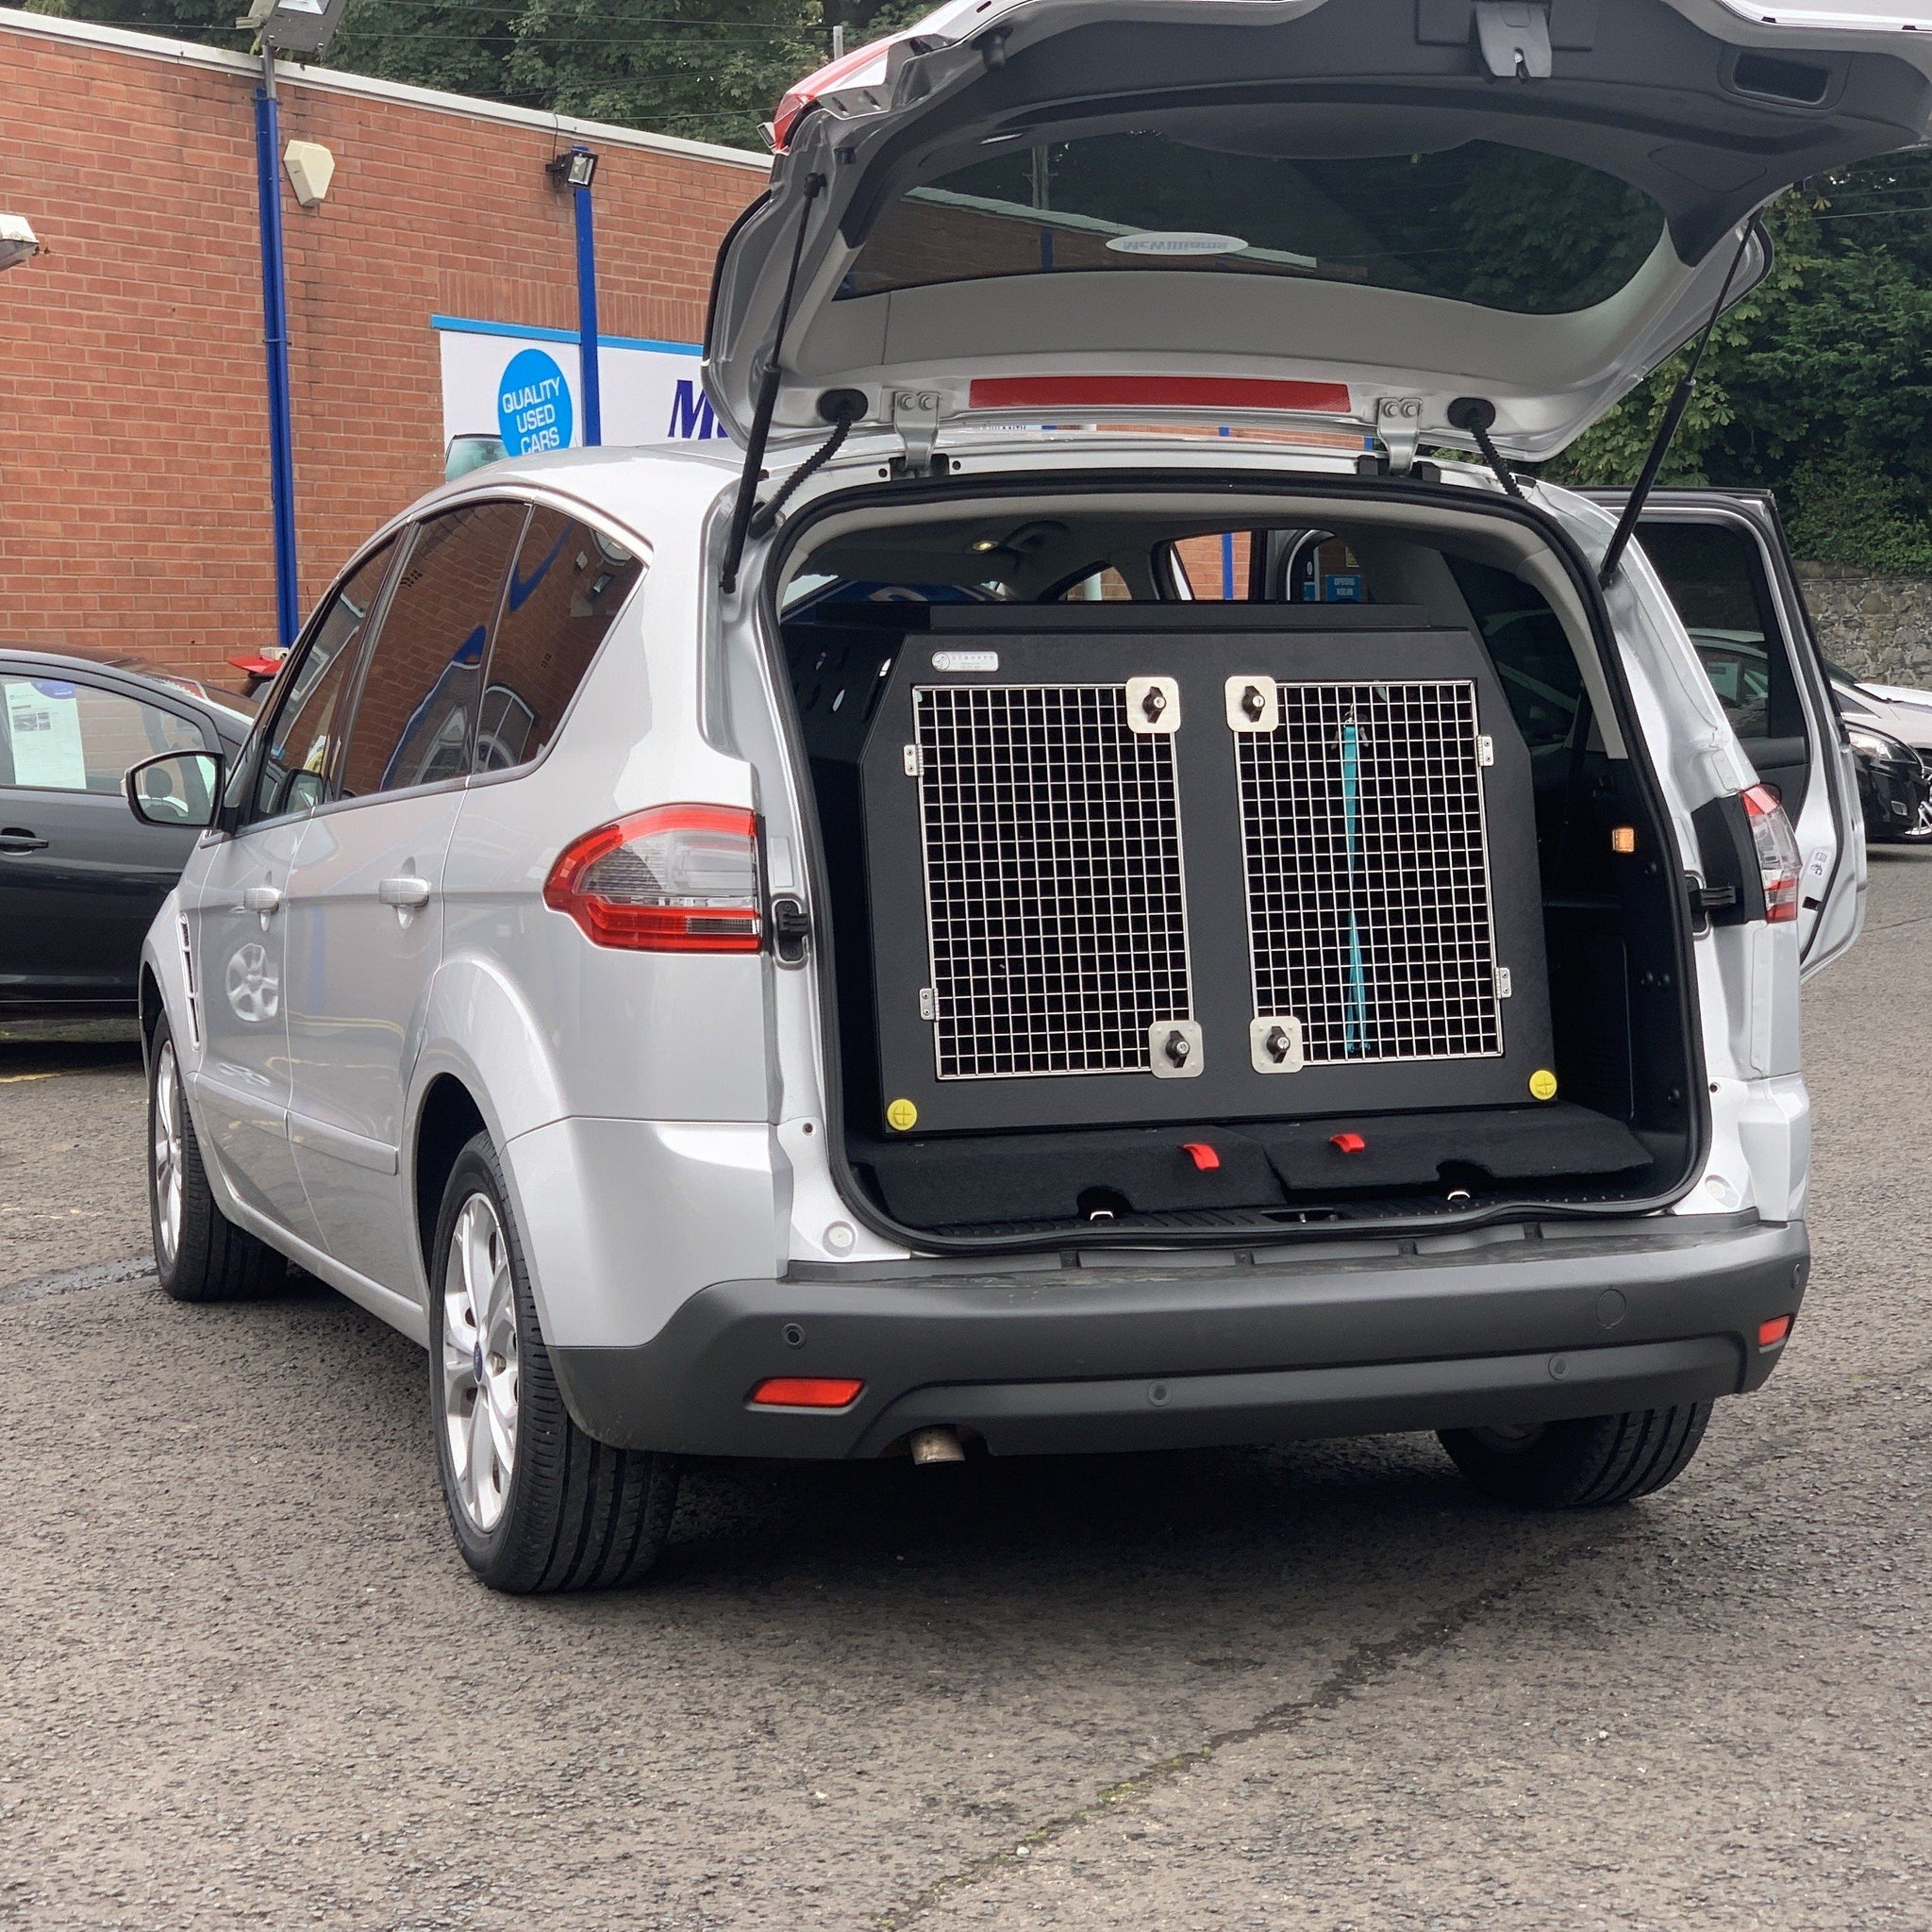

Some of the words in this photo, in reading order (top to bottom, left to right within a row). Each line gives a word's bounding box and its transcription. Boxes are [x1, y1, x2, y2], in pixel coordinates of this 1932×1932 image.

[502, 376, 560, 413] QUALITY
[516, 403, 555, 434] USED
[520, 433, 561, 454] CARS
